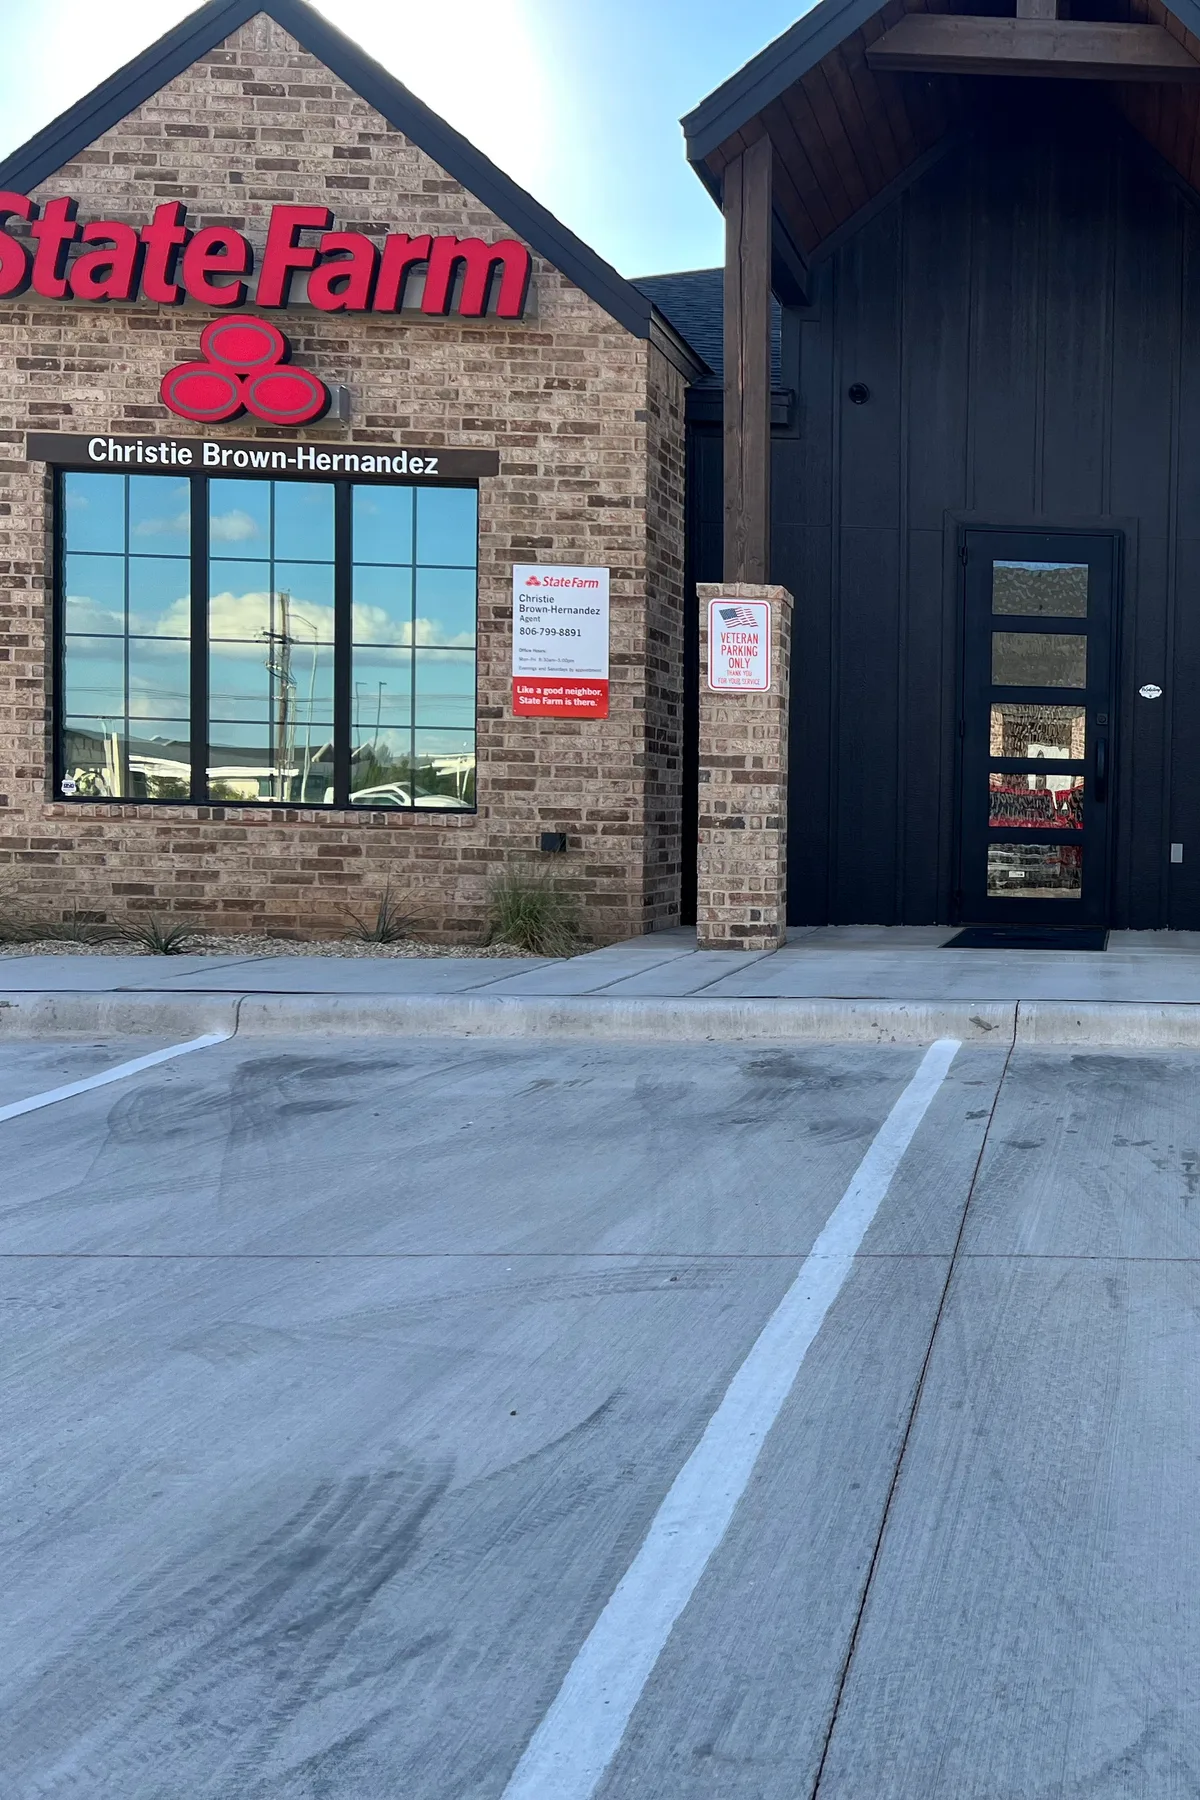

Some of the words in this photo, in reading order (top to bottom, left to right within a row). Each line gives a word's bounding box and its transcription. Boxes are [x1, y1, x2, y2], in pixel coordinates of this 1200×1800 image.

[88, 437, 194, 466] Christie
[202, 443, 440, 475] Brown-Hernandez
[519, 594, 555, 604] Christie
[519, 604, 601, 616] Brown-Hernandez
[519, 615, 541, 623] Agent
[519, 627, 582, 637] 806-799-8891
[720, 632, 758, 644] VETERAN
[721, 645, 758, 657] PARKING
[728, 657, 751, 669] ONLY
[517, 685, 534, 694] Like
[543, 687, 563, 695] good
[565, 688, 603, 697] neighbor,
[518, 696, 541, 704] State
[542, 697, 563, 705] Farm
